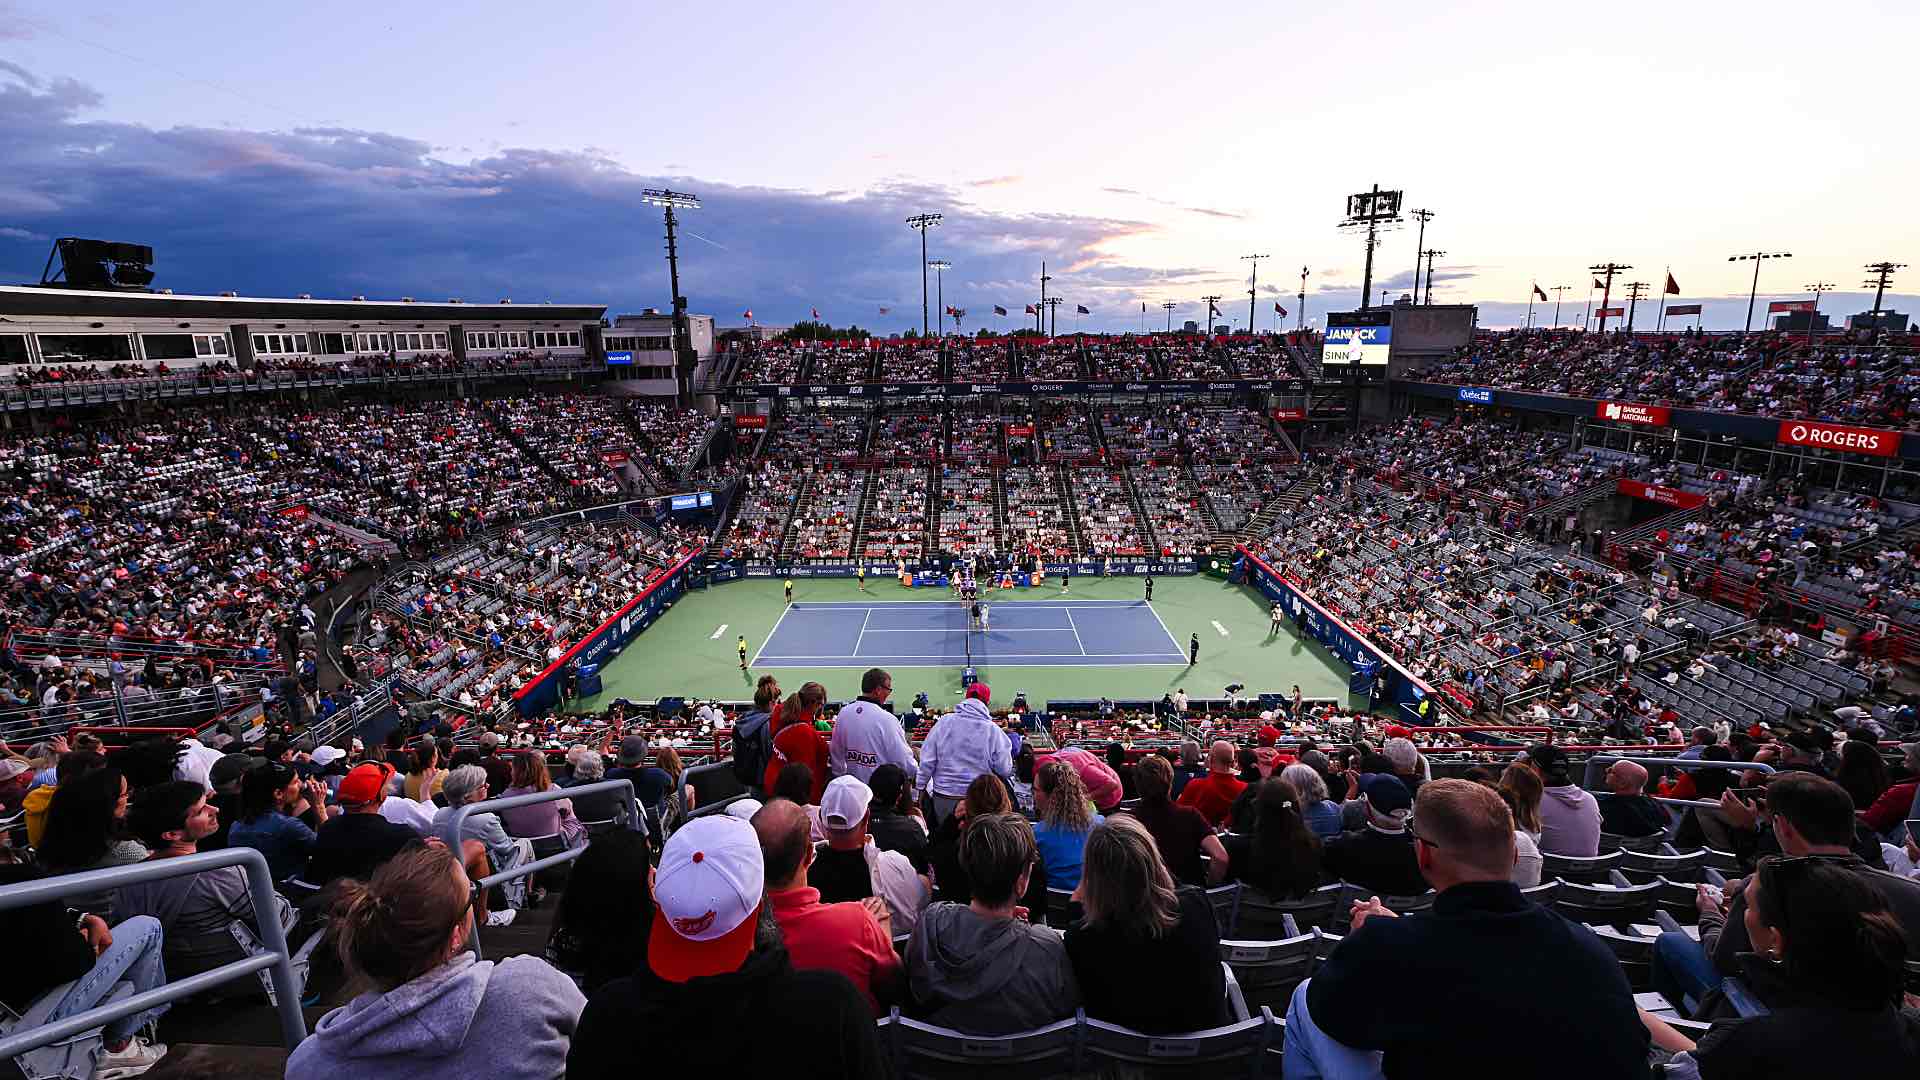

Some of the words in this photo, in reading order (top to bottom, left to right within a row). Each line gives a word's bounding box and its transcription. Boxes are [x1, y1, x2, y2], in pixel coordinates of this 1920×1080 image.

[1326, 328, 1376, 340] JANNCK
[1325, 351, 1363, 360] SINNR
[1622, 405, 1647, 415] BANQUE
[1621, 413, 1653, 423] NATIONALE
[1810, 428, 1879, 449] ROGERS
[380, 671, 400, 687] GERS
[848, 751, 877, 764] NADA
